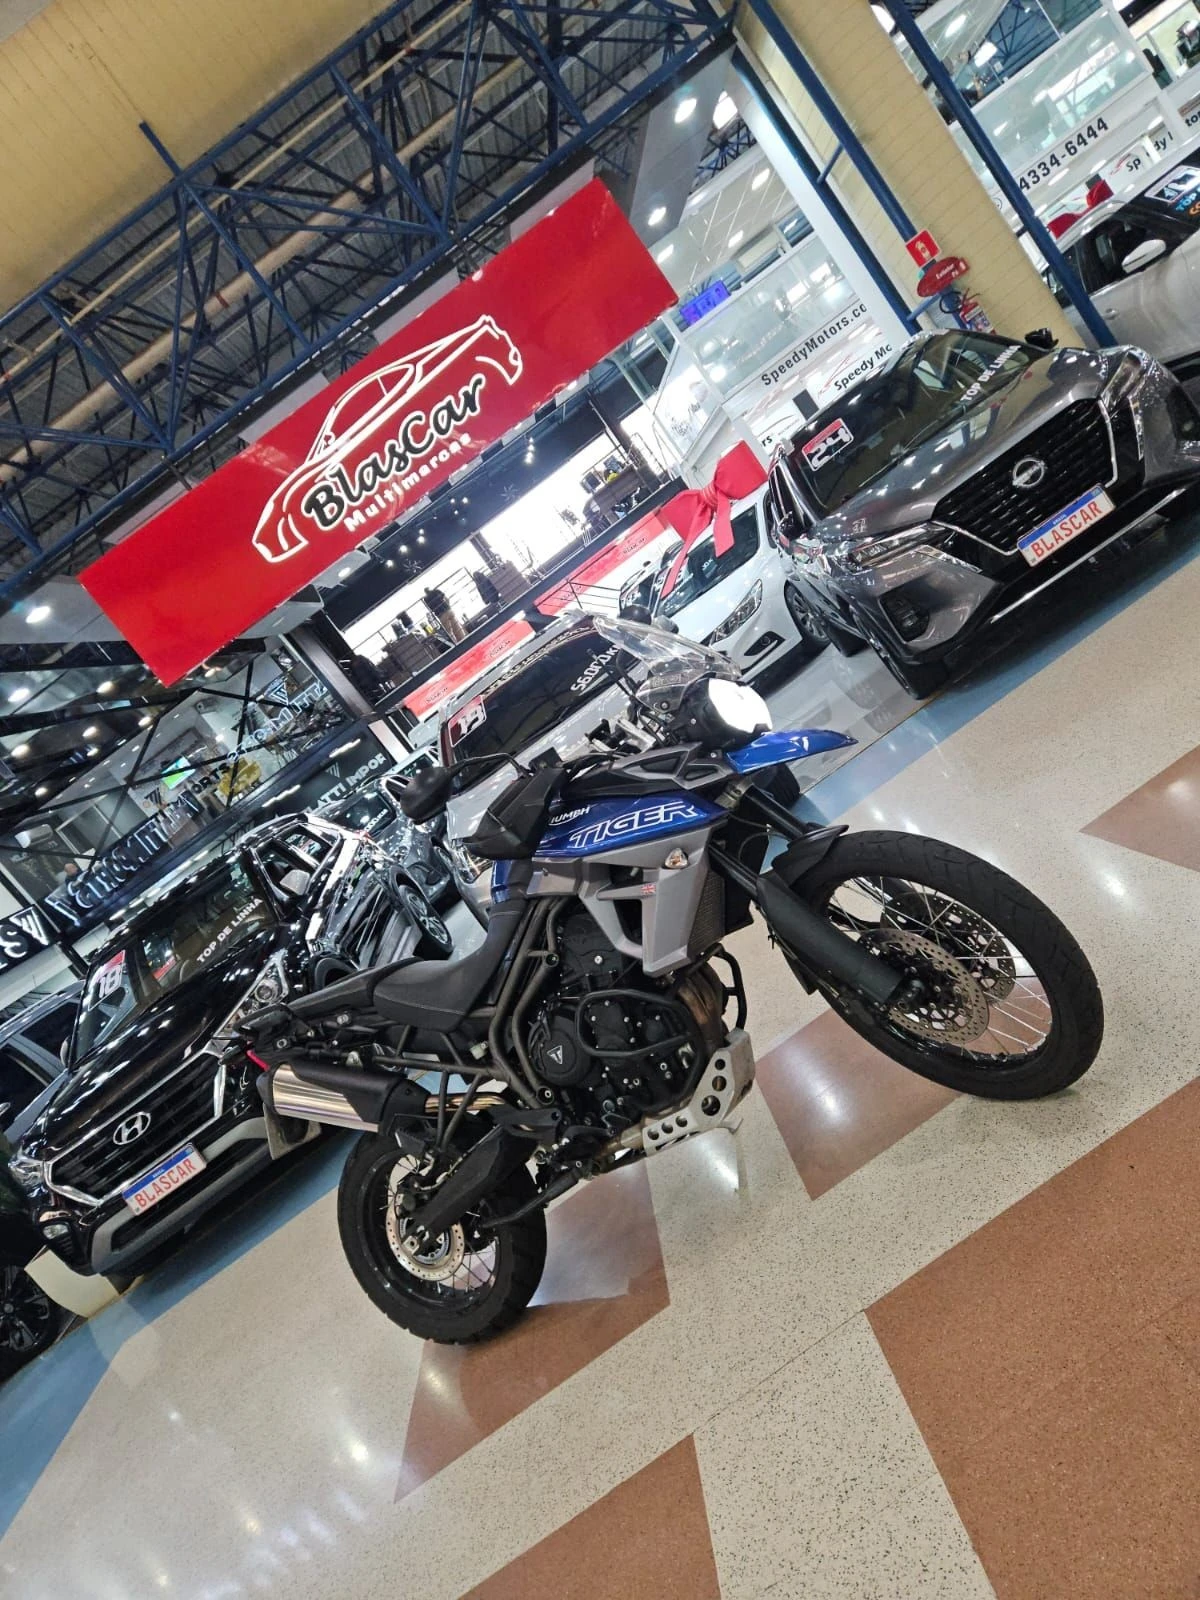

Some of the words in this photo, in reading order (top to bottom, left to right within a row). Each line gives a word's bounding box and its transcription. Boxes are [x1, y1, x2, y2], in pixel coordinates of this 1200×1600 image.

[1018, 117, 1110, 192] 4334-6444
[834, 355, 879, 391] Speedy
[960, 379, 982, 402] TOP
[980, 366, 997, 384] DE
[303, 373, 487, 532] BlasCar
[1031, 500, 1103, 558] BLASCAR
[569, 801, 700, 849] TIGER
[196, 940, 217, 962] TOP
[216, 925, 233, 942] DE
[230, 897, 263, 927] LINHA
[134, 1158, 196, 1207] BLASCAR
